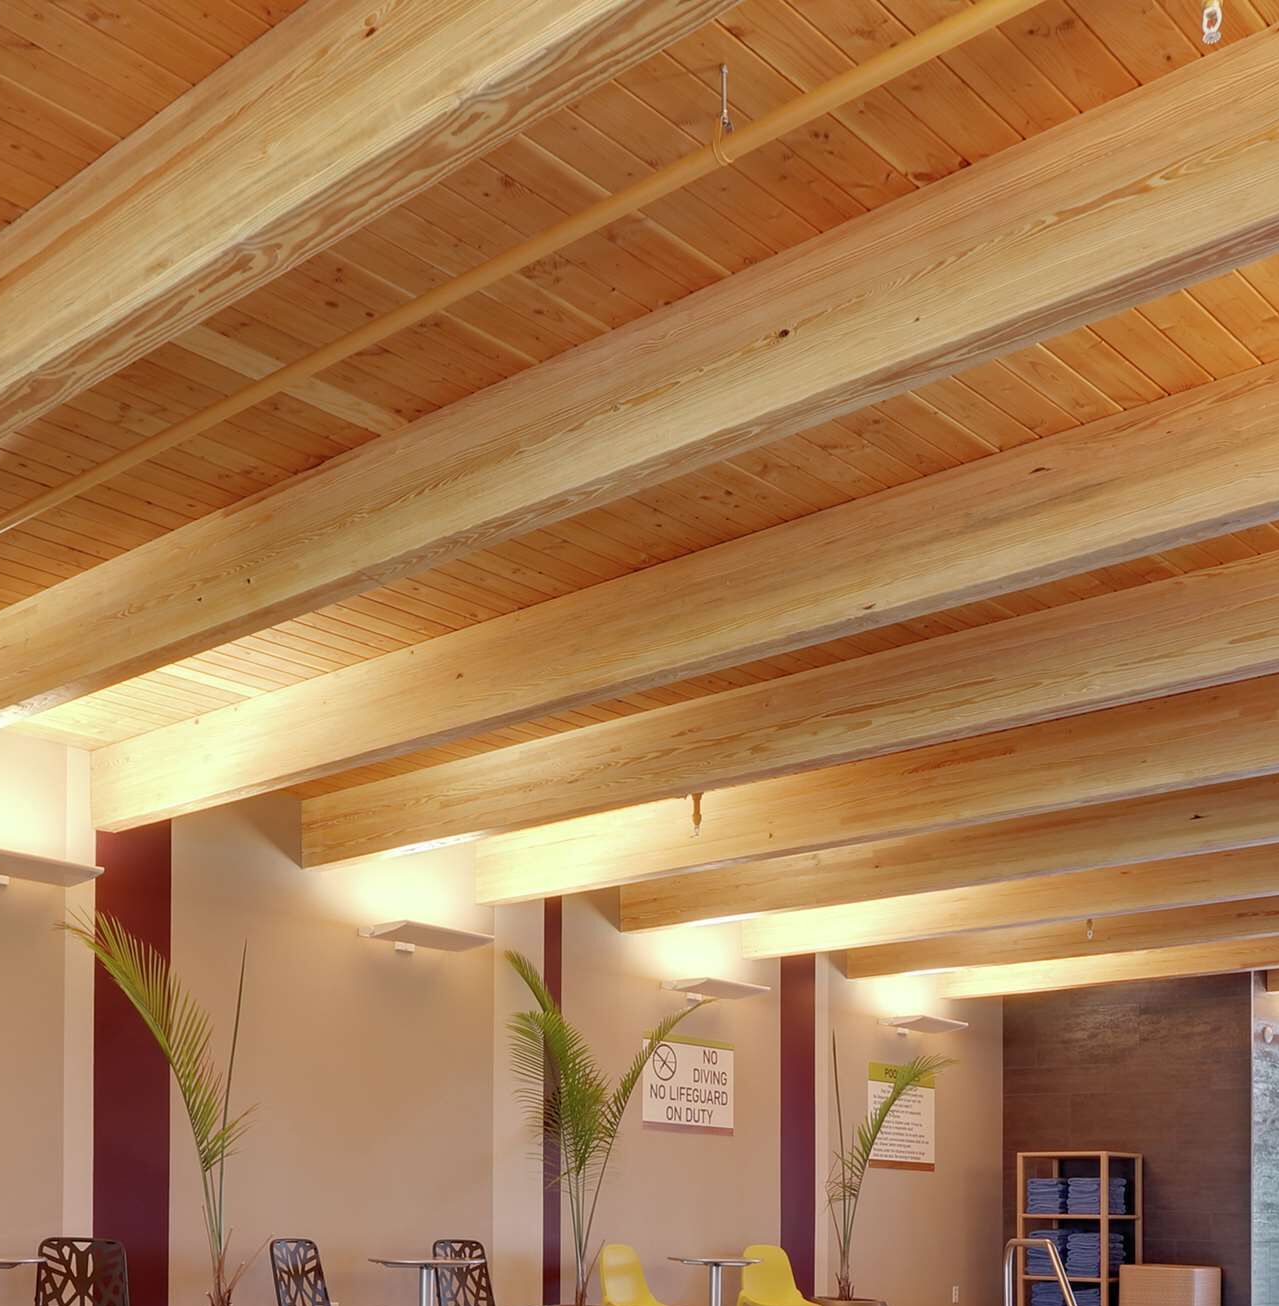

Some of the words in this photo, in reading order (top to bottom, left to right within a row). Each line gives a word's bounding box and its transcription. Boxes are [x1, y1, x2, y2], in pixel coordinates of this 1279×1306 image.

[703, 1050, 718, 1065] NO
[693, 1068, 728, 1086] DIVING
[650, 1083, 666, 1099] NO
[669, 1086, 729, 1106] LIFEGUARD
[666, 1106, 682, 1121] ON
[686, 1108, 713, 1124] DUTY
